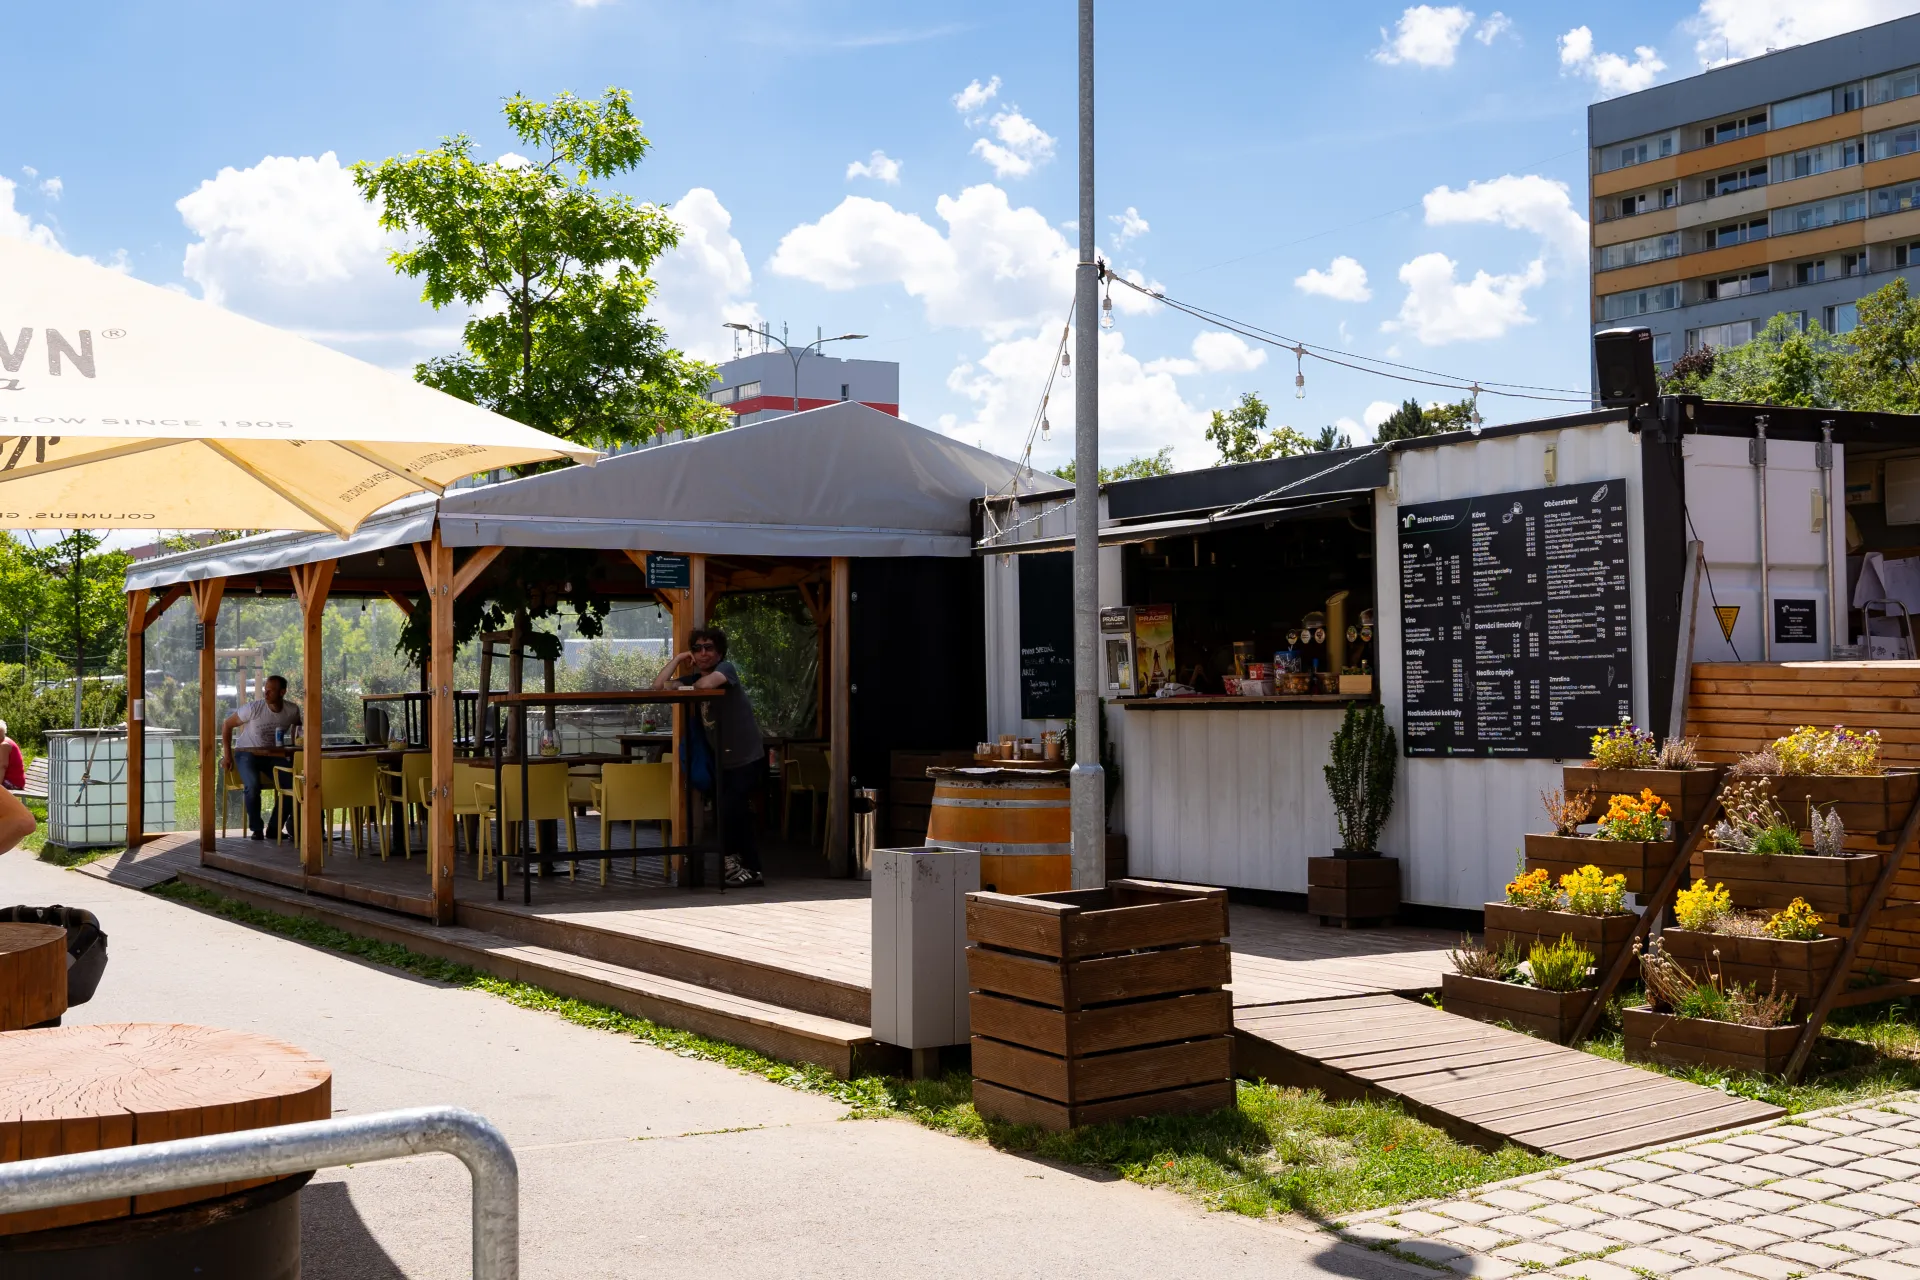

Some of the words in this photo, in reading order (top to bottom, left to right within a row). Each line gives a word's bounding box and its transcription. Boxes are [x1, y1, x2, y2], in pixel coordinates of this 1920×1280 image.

[101, 418, 202, 427] SINCE
[218, 420, 293, 428] 1905
[1544, 497, 1578, 507] Občerstvení
[1496, 621, 1522, 630] limonády
[1495, 668, 1514, 677] nápoje
